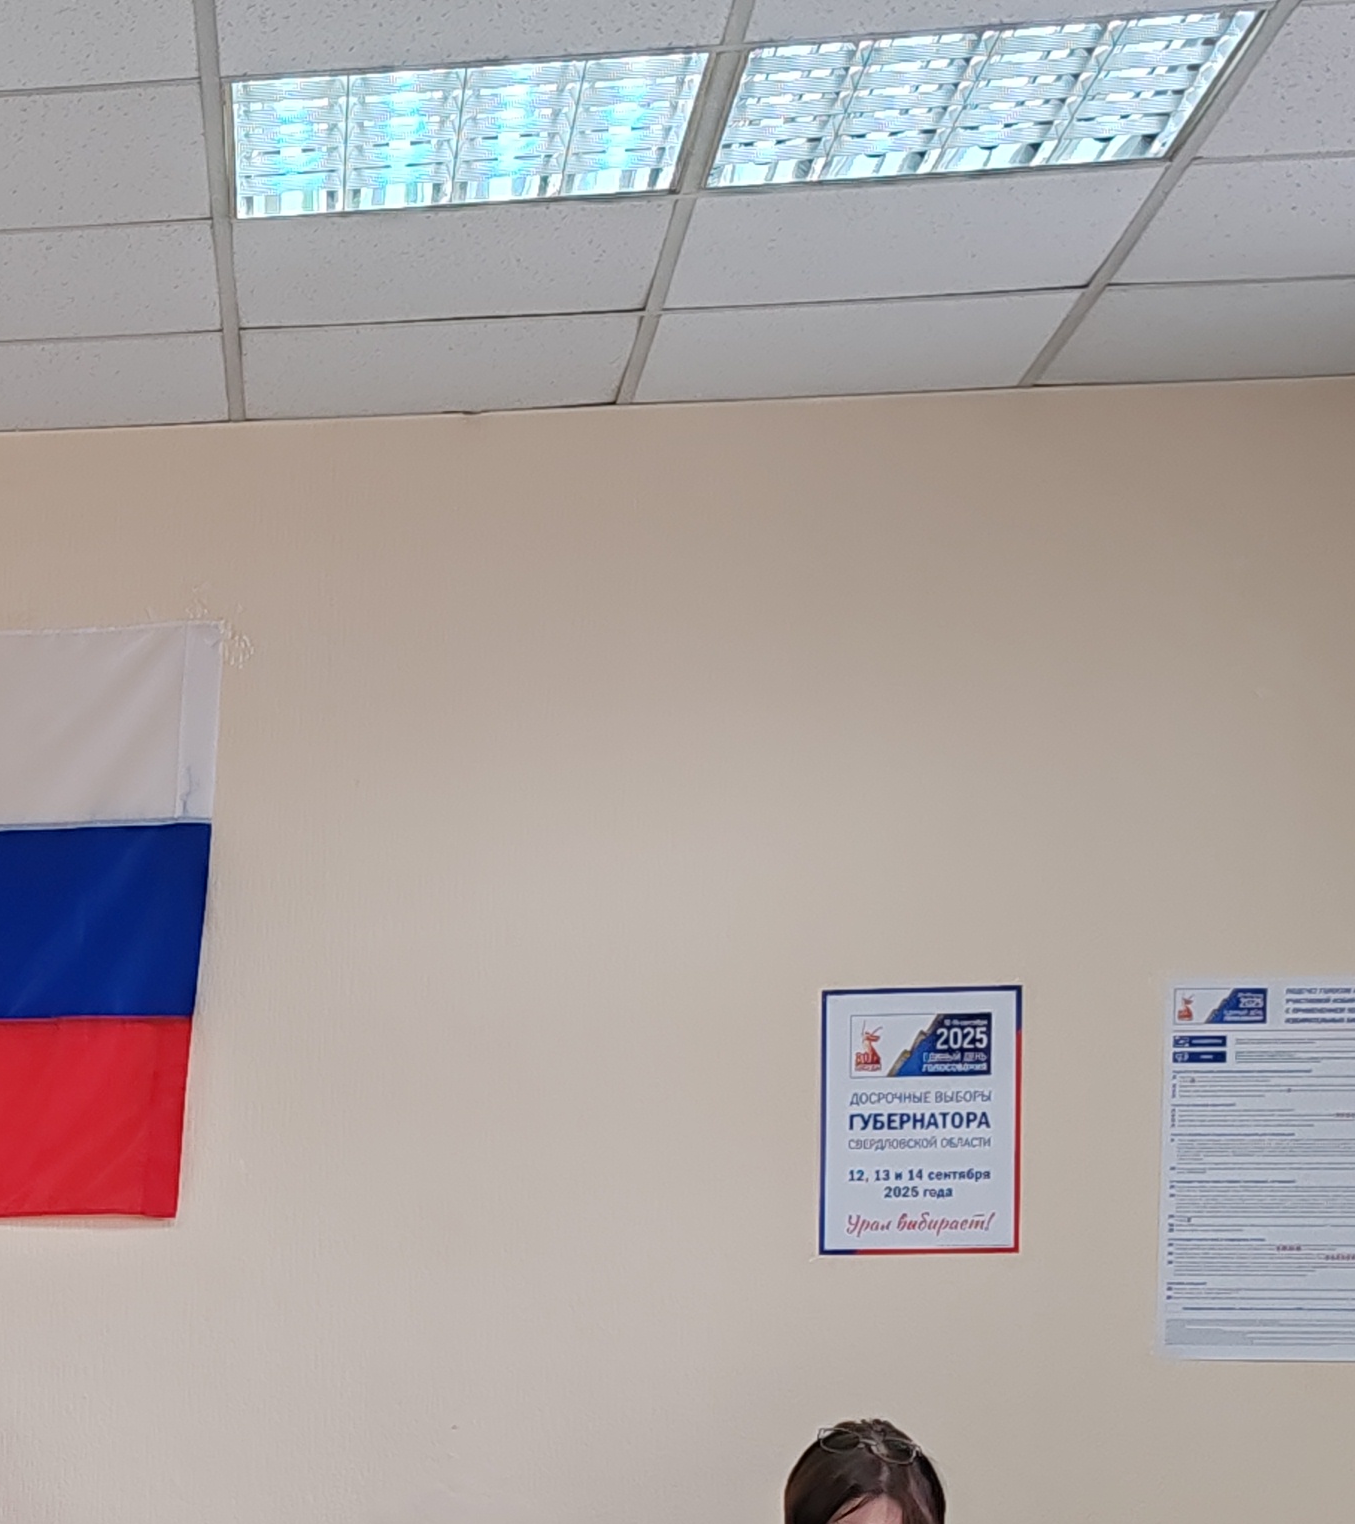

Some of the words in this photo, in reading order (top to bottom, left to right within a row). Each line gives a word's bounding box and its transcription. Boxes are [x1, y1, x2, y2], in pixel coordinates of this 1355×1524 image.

[936, 1026, 988, 1050] 2025
[849, 1091, 932, 1106] ДОСРОЧНЫЕ
[934, 1090, 992, 1104] ВЫБОРЫ
[848, 1111, 992, 1131] ГУБЕРНАТОРА
[848, 1136, 938, 1151] СВЕРДЛОВСКОЙ
[940, 1136, 992, 1148] ОБЛАСТИ
[848, 1169, 869, 1183] 12,
[874, 1169, 891, 1181] 13
[894, 1170, 904, 1181] и
[907, 1169, 924, 1181] 14
[927, 1168, 992, 1182] сентября
[884, 1186, 920, 1199] 2025
[923, 1187, 954, 1199] года
[846, 1214, 893, 1238] Урал
